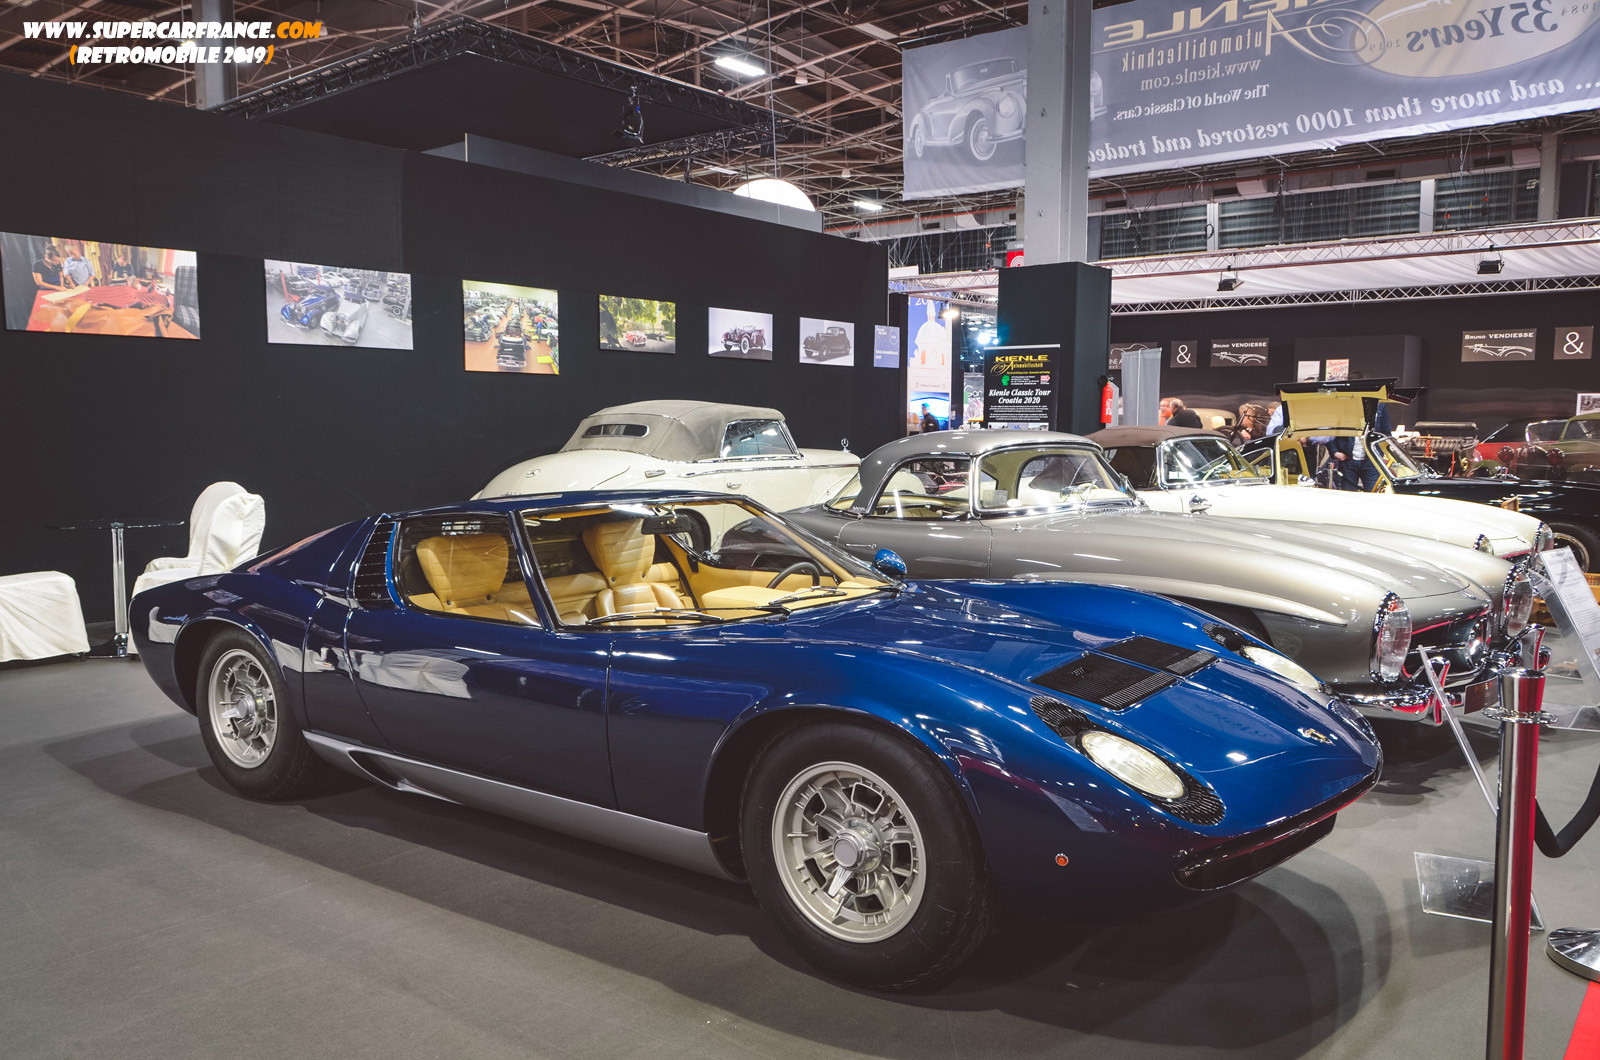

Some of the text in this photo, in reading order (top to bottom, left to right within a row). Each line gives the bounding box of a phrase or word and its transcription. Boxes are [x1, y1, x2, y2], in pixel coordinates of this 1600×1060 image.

[1563, 331, 1584, 355] &
[995, 354, 1049, 362] KIENLE
[1176, 344, 1192, 364] &
[988, 389, 1010, 397] Kienle
[1034, 388, 1051, 396] Tour
[1023, 396, 1041, 404] 2020
